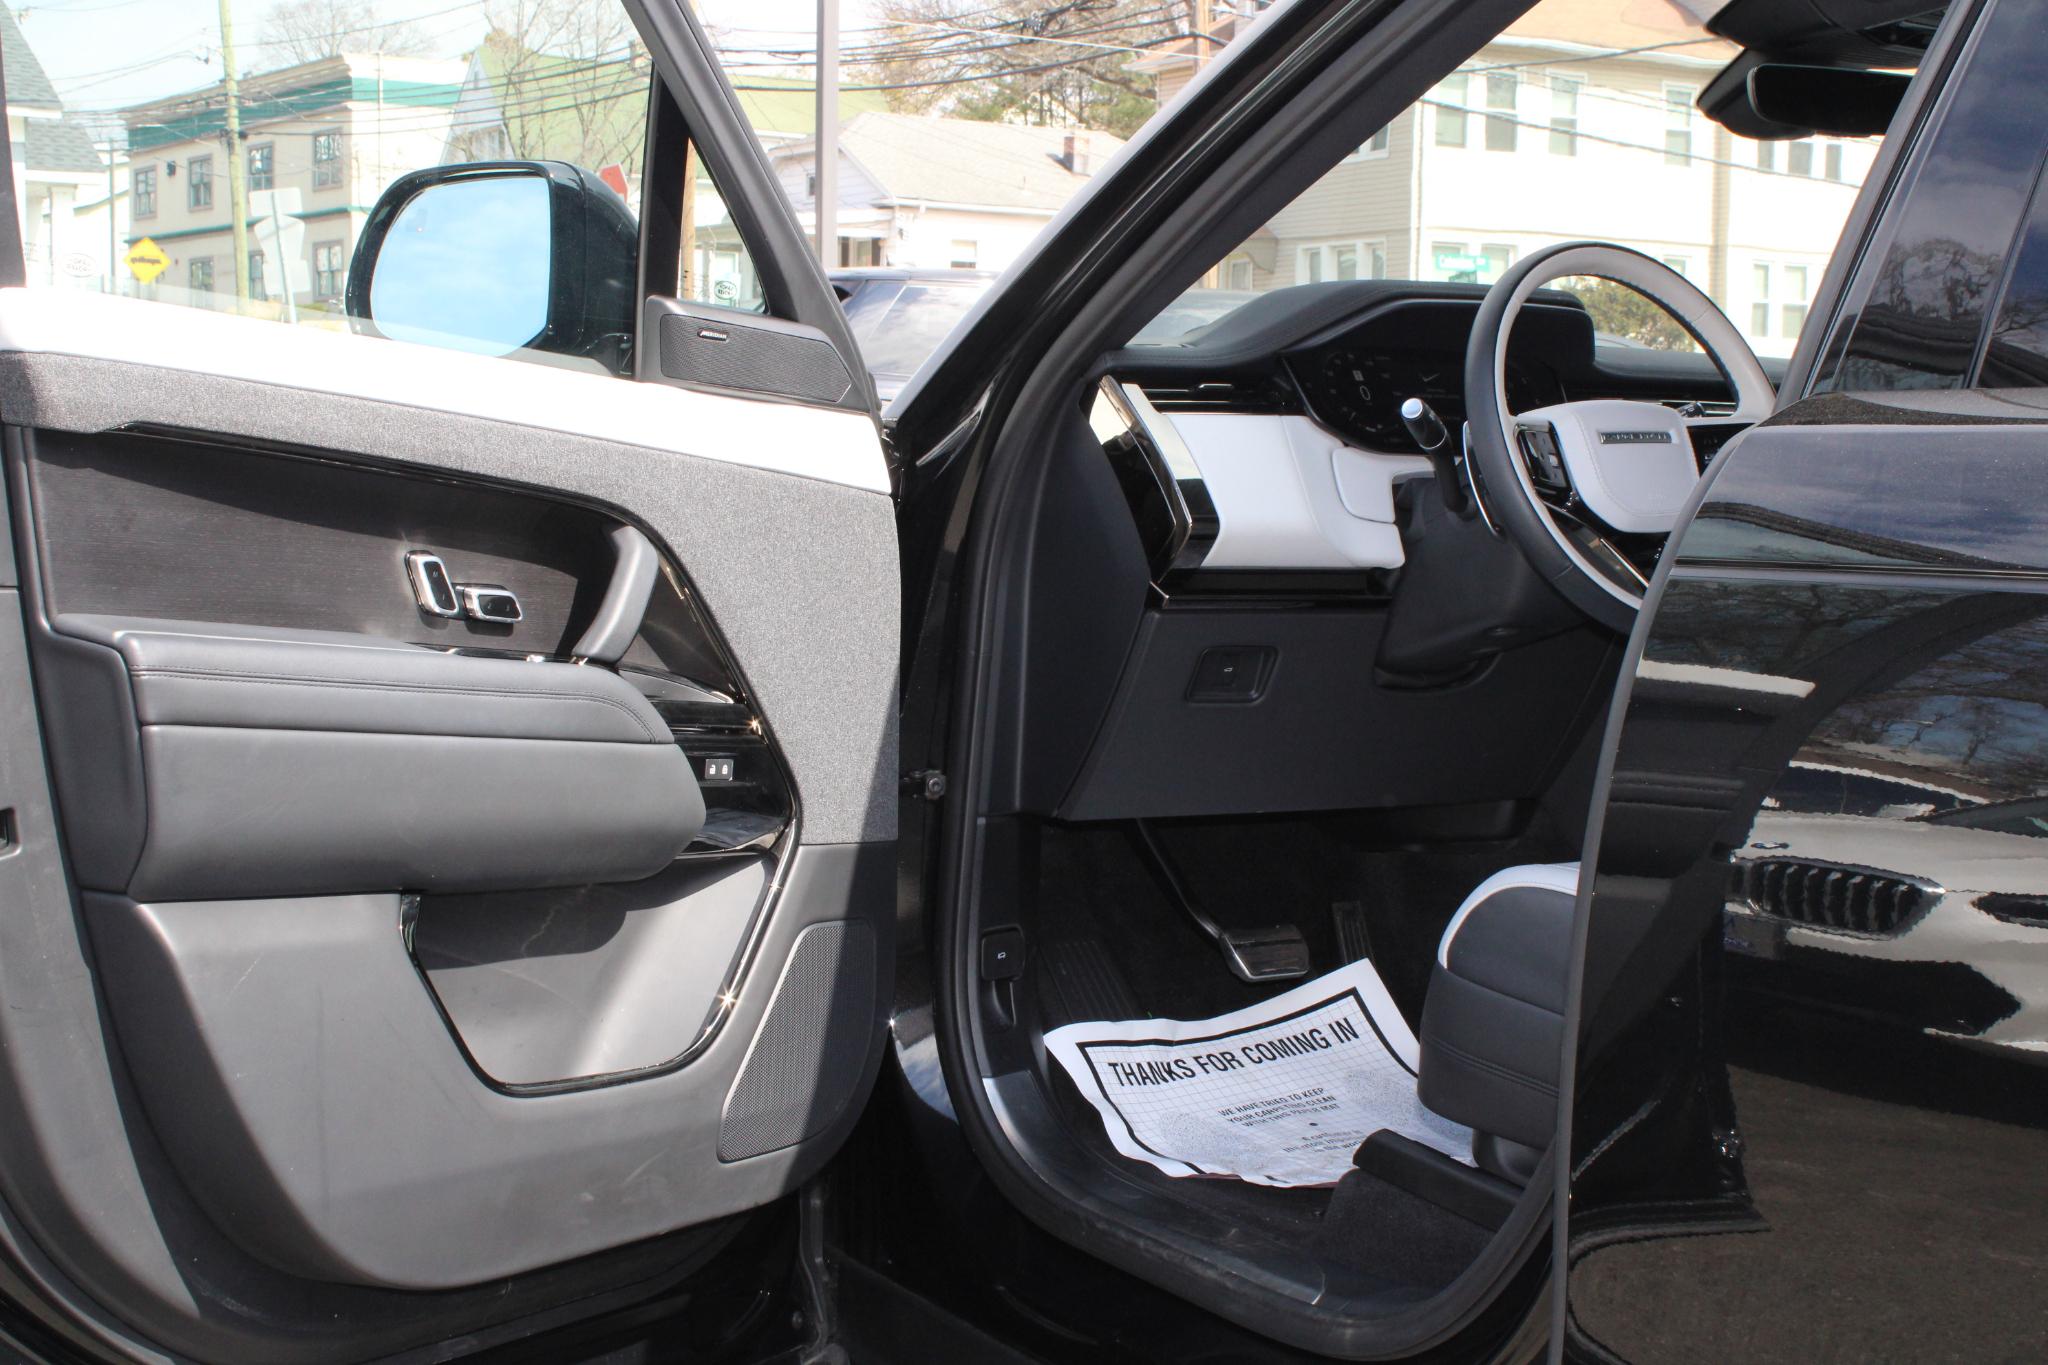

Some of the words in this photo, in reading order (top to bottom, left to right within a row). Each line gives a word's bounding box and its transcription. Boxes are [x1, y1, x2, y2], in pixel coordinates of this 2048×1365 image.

[1108, 1059, 1196, 1086] THANKS
[1192, 1052, 1245, 1074] FOR
[1241, 1028, 1332, 1064] COMING
[1328, 1017, 1359, 1043] IN
[1217, 1108, 1236, 1117] WE
[1235, 1102, 1260, 1113] HAVE
[1259, 1096, 1288, 1108] TRIED
[1288, 1093, 1302, 1101] TO
[1301, 1087, 1324, 1098] KEEP
[1226, 1113, 1254, 1124] YOUR
[1305, 1095, 1337, 1106] CLEAN
[1319, 1102, 1341, 1111] MAT
